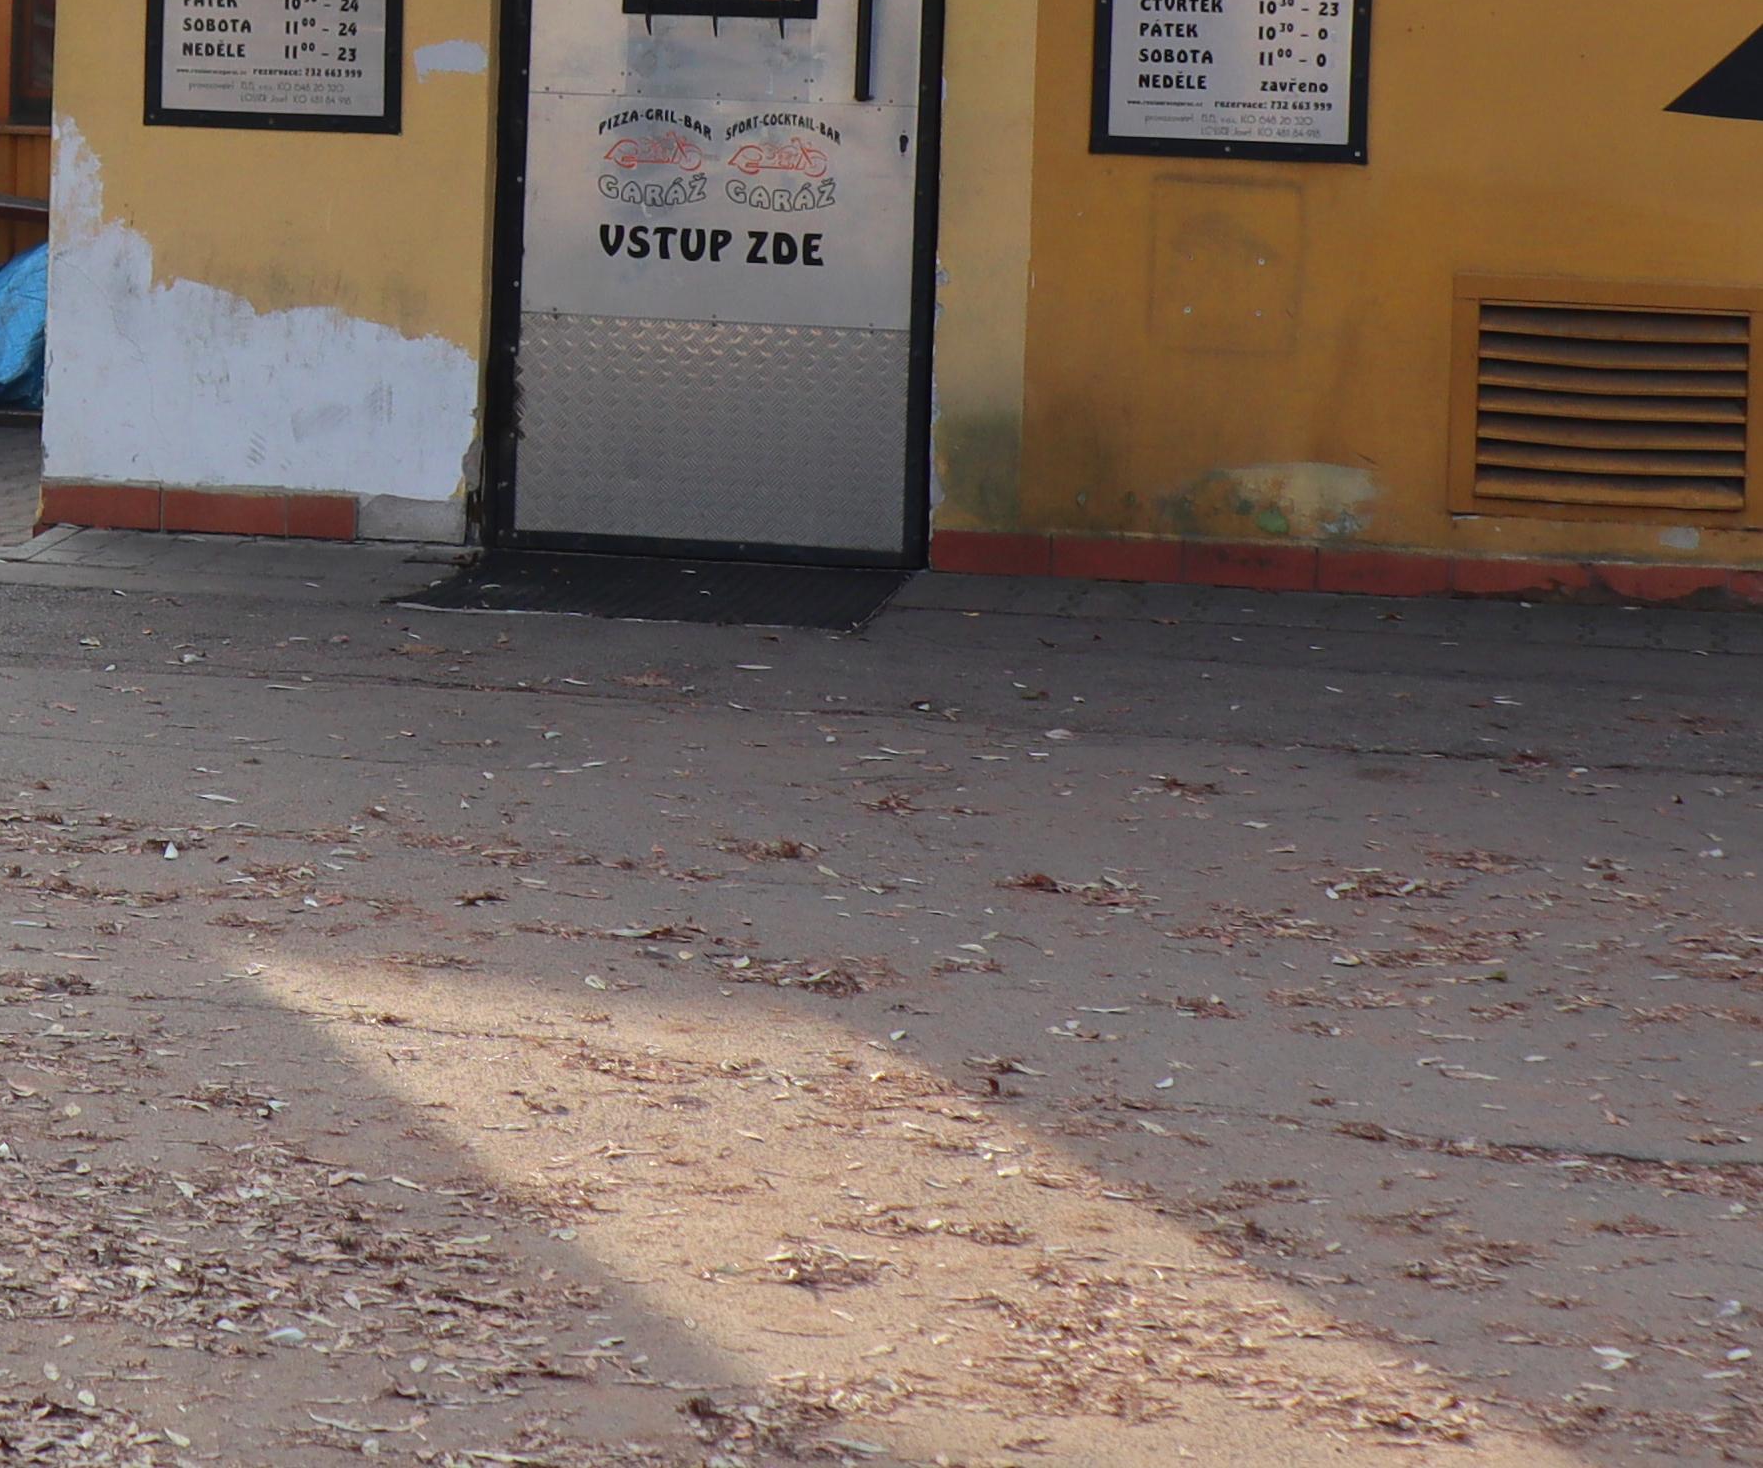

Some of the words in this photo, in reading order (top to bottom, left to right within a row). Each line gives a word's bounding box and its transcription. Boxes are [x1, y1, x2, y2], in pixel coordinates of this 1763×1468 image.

[1318, 1, 1340, 17] 23
[338, 22, 358, 37] 24
[1317, 27, 1329, 41] 0
[337, 46, 357, 63] 23
[1316, 53, 1327, 68] 0
[598, 172, 708, 208] GARÁŽ
[725, 177, 837, 213] GARÁŽ
[599, 223, 733, 263] VSTUP
[745, 230, 824, 267] ZDE
